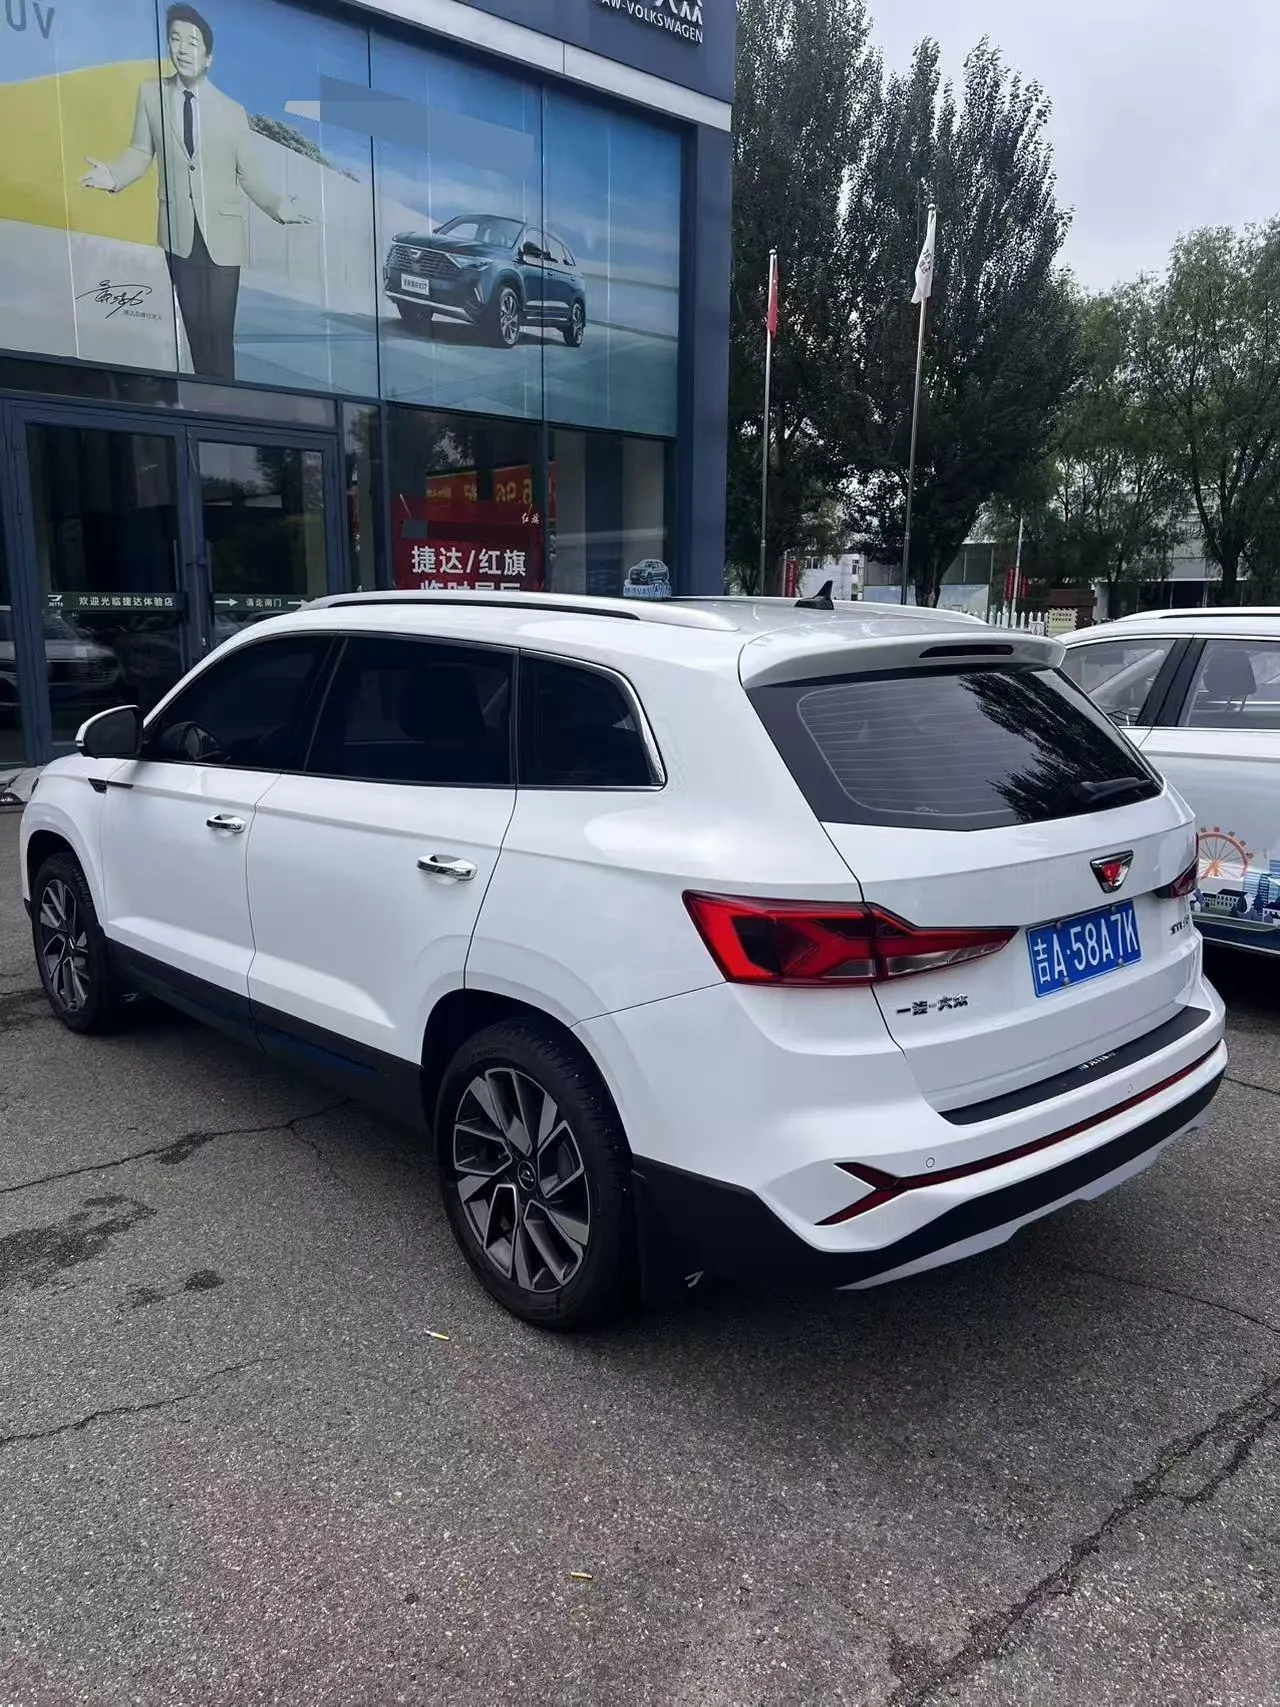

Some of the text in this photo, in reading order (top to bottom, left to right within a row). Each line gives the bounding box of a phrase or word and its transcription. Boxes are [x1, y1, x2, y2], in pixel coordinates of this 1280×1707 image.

[411, 545, 526, 576] 捷达/红旗
[79, 596, 173, 607] 欢迎光临捷达体验店
